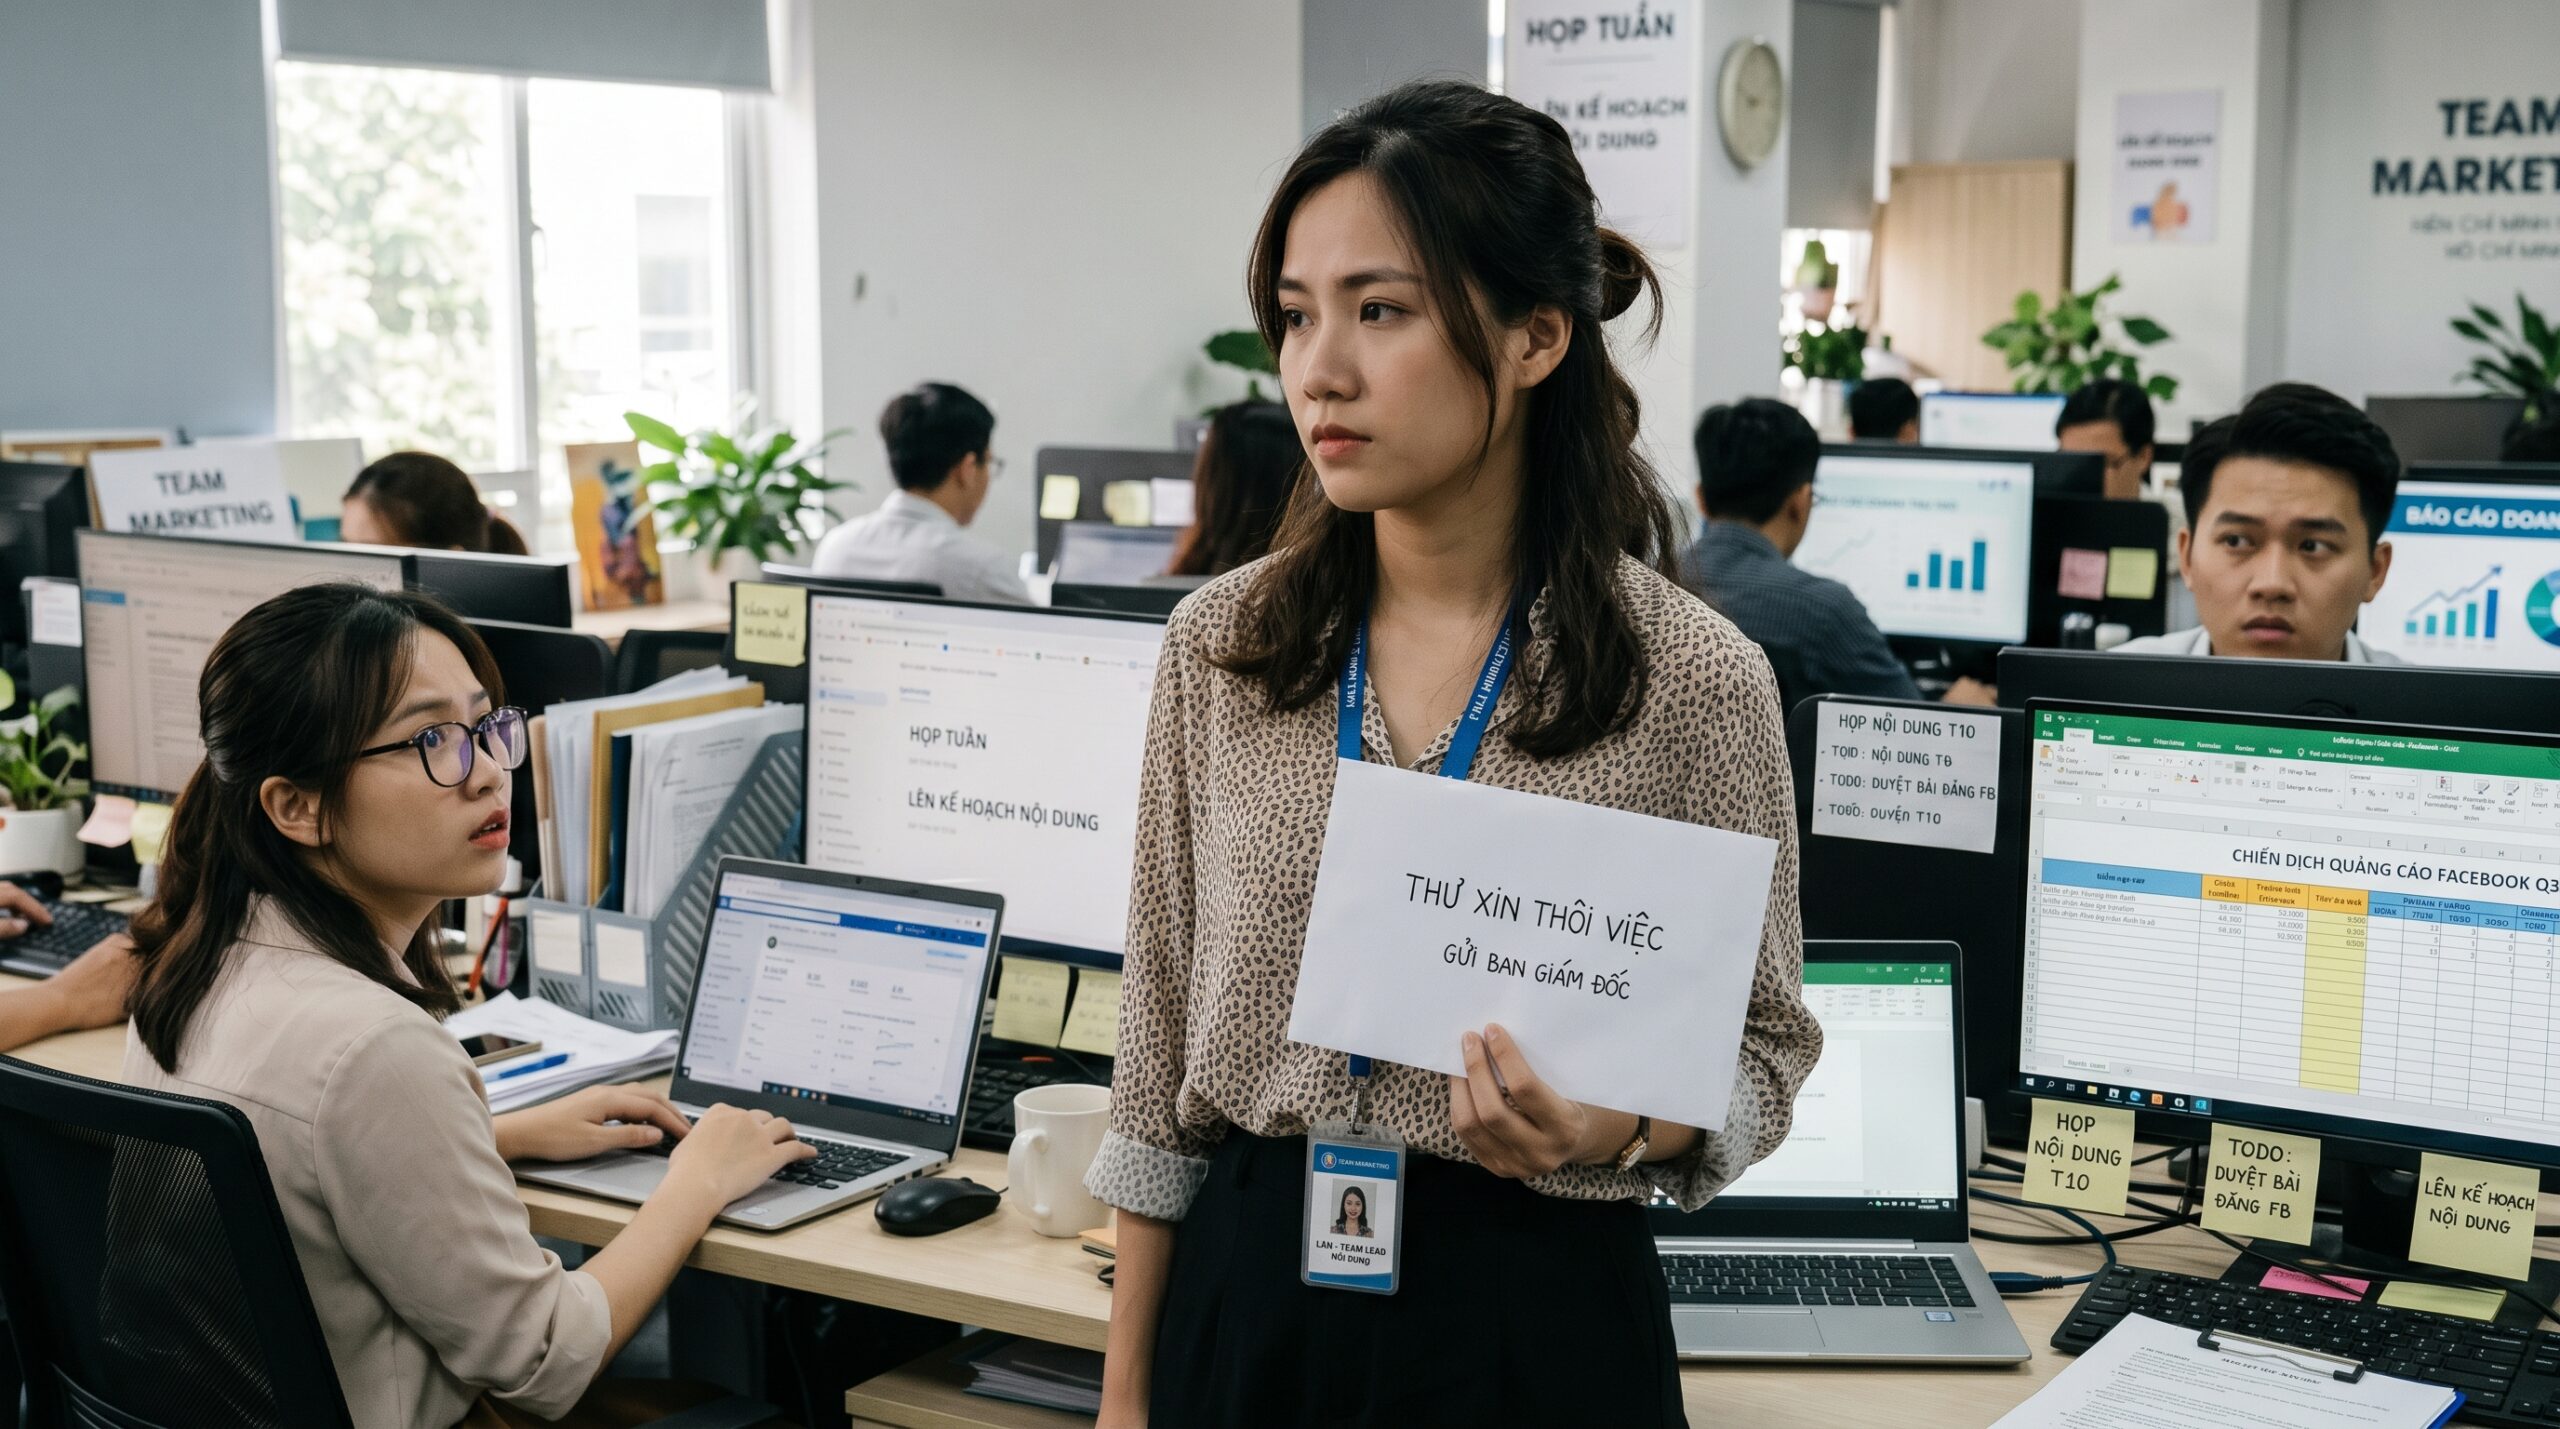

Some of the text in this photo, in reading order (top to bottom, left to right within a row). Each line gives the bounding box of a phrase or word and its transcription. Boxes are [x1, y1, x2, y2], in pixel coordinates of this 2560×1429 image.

[1526, 18, 1587, 51] HỌP
[2439, 98, 2560, 138] TEAM
[1597, 128, 1658, 149] DUNG
[154, 467, 227, 496] TEAM
[128, 502, 274, 535] MARKETING
[2405, 502, 2451, 527] BÁO
[2453, 504, 2501, 528] CÁO
[909, 725, 988, 750] HỌP TUẦN
[1839, 713, 1867, 734] HỌP
[1903, 719, 1942, 736] DUNG
[1948, 723, 1976, 739] T10
[1897, 751, 1930, 766] DUNG
[1979, 786, 1997, 801] FB
[908, 787, 1099, 831] LÊN KẾ HOẠCH NỘI DUNG
[1916, 811, 1943, 825] T10
[2232, 847, 2560, 895] CHIẾN DỊCH QUẢNG CÁO FACEBOOK Q3
[1406, 872, 1465, 909] THƯ
[1486, 952, 1527, 978] BAN
[1590, 968, 1631, 1000] ĐỐC
[2056, 1112, 2096, 1137] HỌP
[2071, 1144, 2122, 1166] DUNG
[2050, 1169, 2090, 1191] T10
[2215, 1165, 2268, 1191] DUYỆT
[2214, 1191, 2291, 1219] ĐĂNG FB
[2424, 1176, 2535, 1212] LÊN KẾ HOẠCH
[2465, 1214, 2511, 1234] DUNG
[1316, 1239, 1333, 1249] LAN
[1340, 1243, 1363, 1253] TEAM
[1364, 1246, 1387, 1256] LEAD
